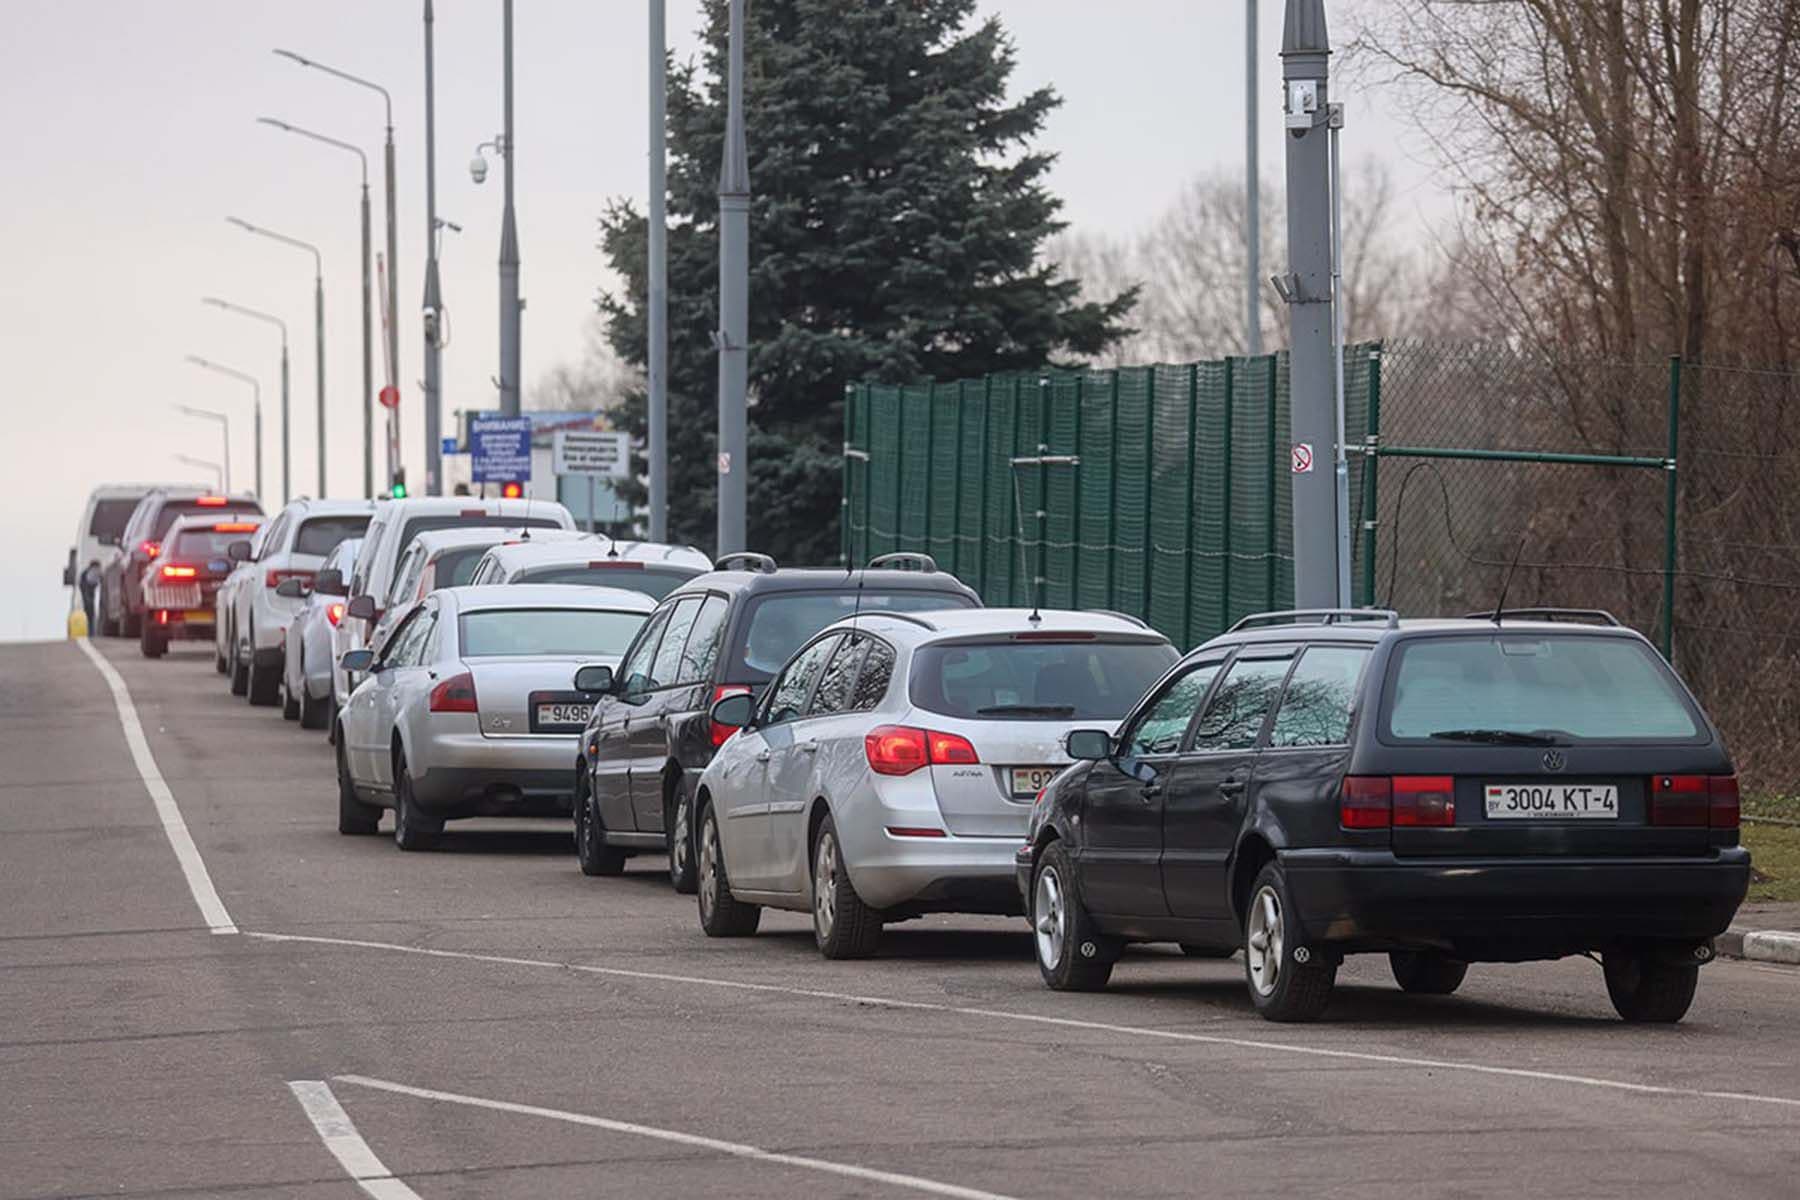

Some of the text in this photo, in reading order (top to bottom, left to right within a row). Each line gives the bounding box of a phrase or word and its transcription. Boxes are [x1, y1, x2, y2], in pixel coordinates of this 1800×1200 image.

[553, 706, 589, 721] 9496
[1506, 788, 1614, 810] 3004 KT-4
